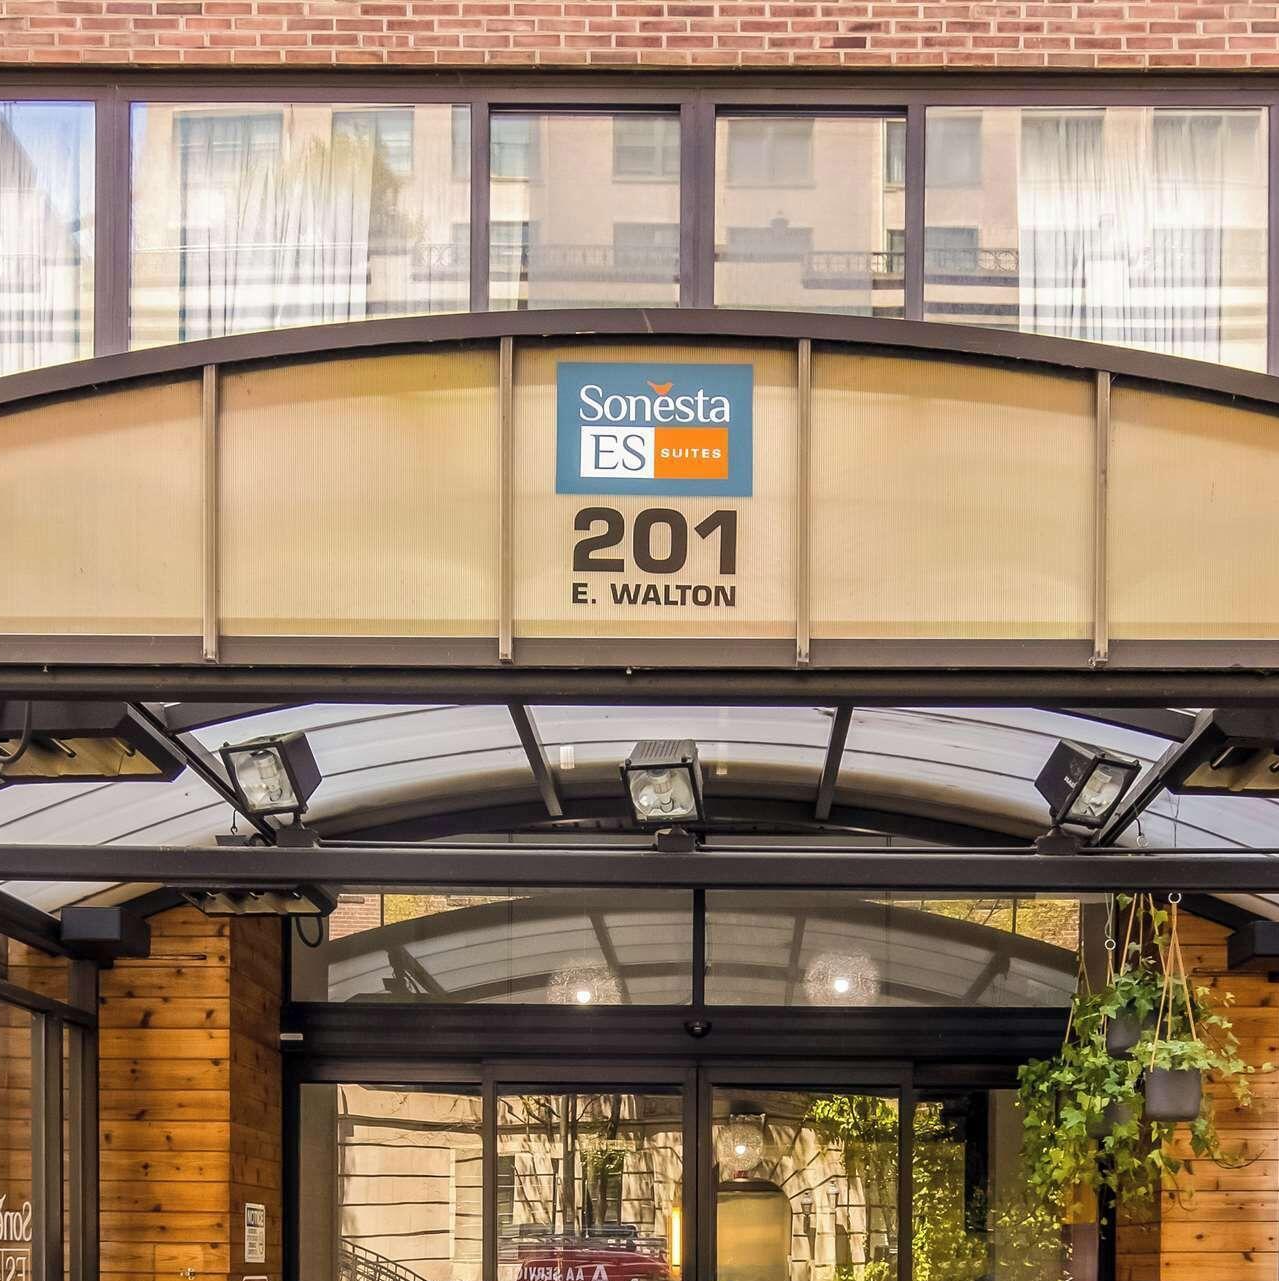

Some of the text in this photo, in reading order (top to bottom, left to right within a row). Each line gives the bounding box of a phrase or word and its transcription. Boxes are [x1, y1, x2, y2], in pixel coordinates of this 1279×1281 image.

[590, 433, 721, 471] ES SUITES
[572, 506, 737, 575] 201
[572, 582, 736, 607] E. WALTON
